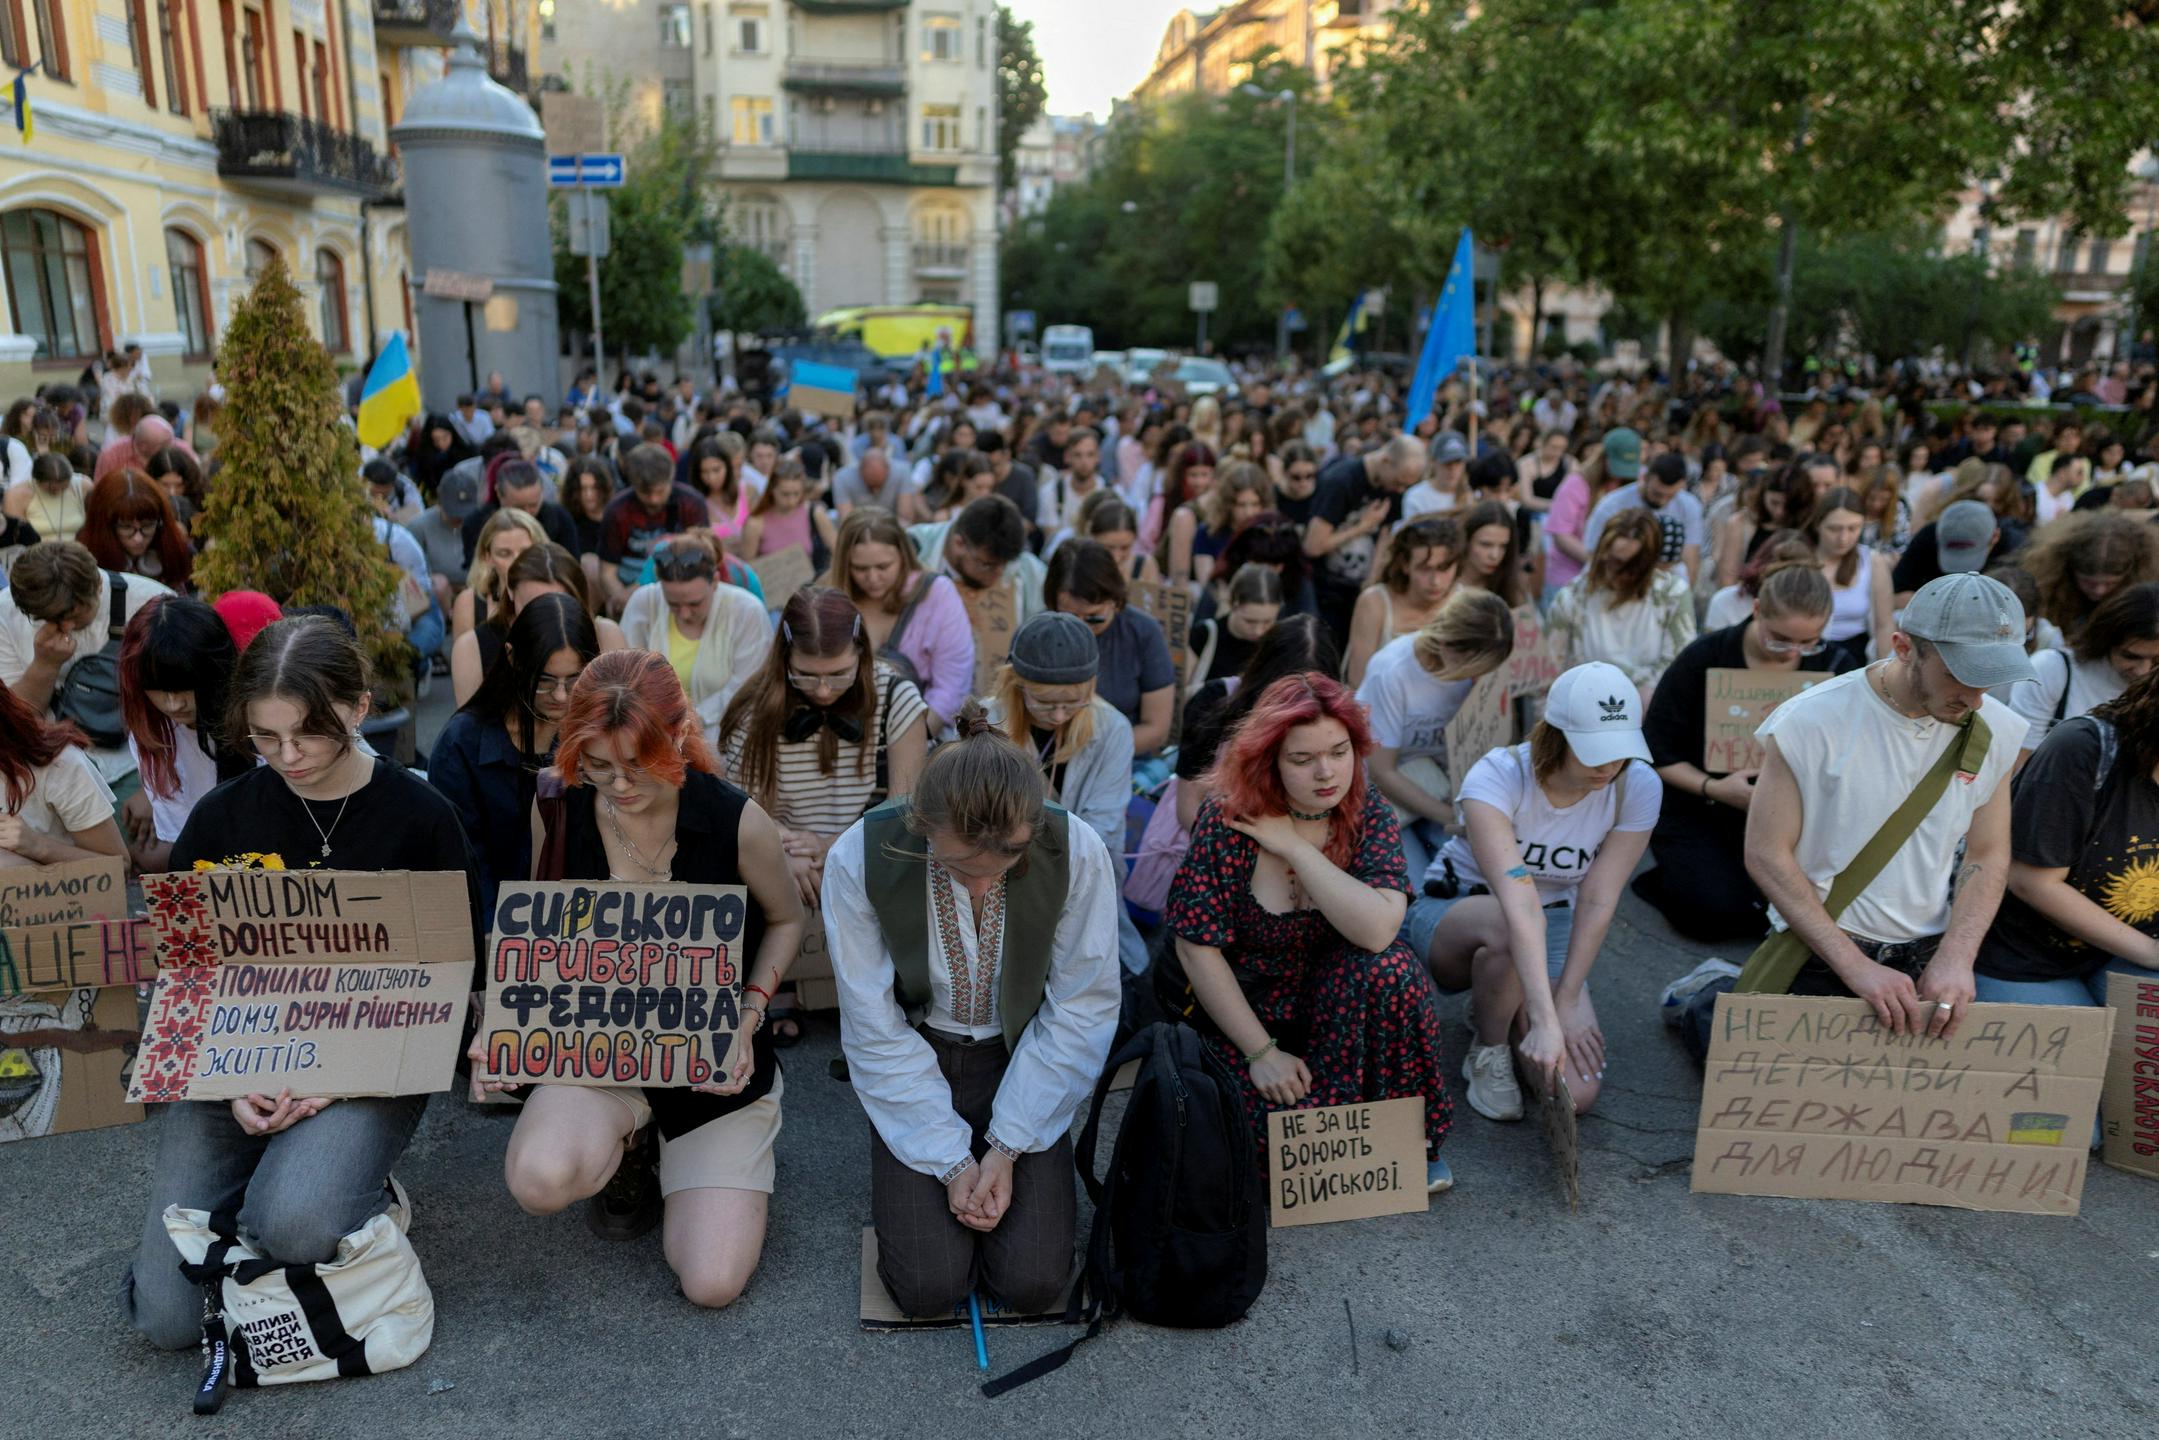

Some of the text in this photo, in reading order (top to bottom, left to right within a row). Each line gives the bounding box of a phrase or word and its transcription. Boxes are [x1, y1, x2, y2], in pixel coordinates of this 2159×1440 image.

[1600, 713, 1628, 722] adidas
[208, 871, 276, 919] МІЙ
[281, 875, 341, 918] ДІМ
[497, 887, 745, 942] СИРСЬКОГО
[335, 968, 431, 993] КОШТУЮТЬ
[284, 997, 353, 1032] ДУРНІ
[353, 995, 453, 1030] РІШЕННЯ
[1725, 1006, 1777, 1042] НЕ
[1964, 1021, 2070, 1066] ДЛЯ
[200, 1038, 323, 1077] ЖИТТІВ.
[487, 1028, 734, 1084] ПОНОВІТЬ!
[2003, 1067, 2040, 1101] А
[1282, 1108, 1371, 1139] НЕ ЗА ЦЕ
[1710, 1096, 1993, 1143] ДЕРЖАВА
[1280, 1136, 1372, 1171] ВОЮЮТЬ
[1711, 1141, 2079, 1206] ДЛЯ ЛЮДИНИ!
[1281, 1161, 1402, 1209] ВІЙСЬКОВІ.
[203, 1340, 225, 1392] СХІДНЯЧКА
